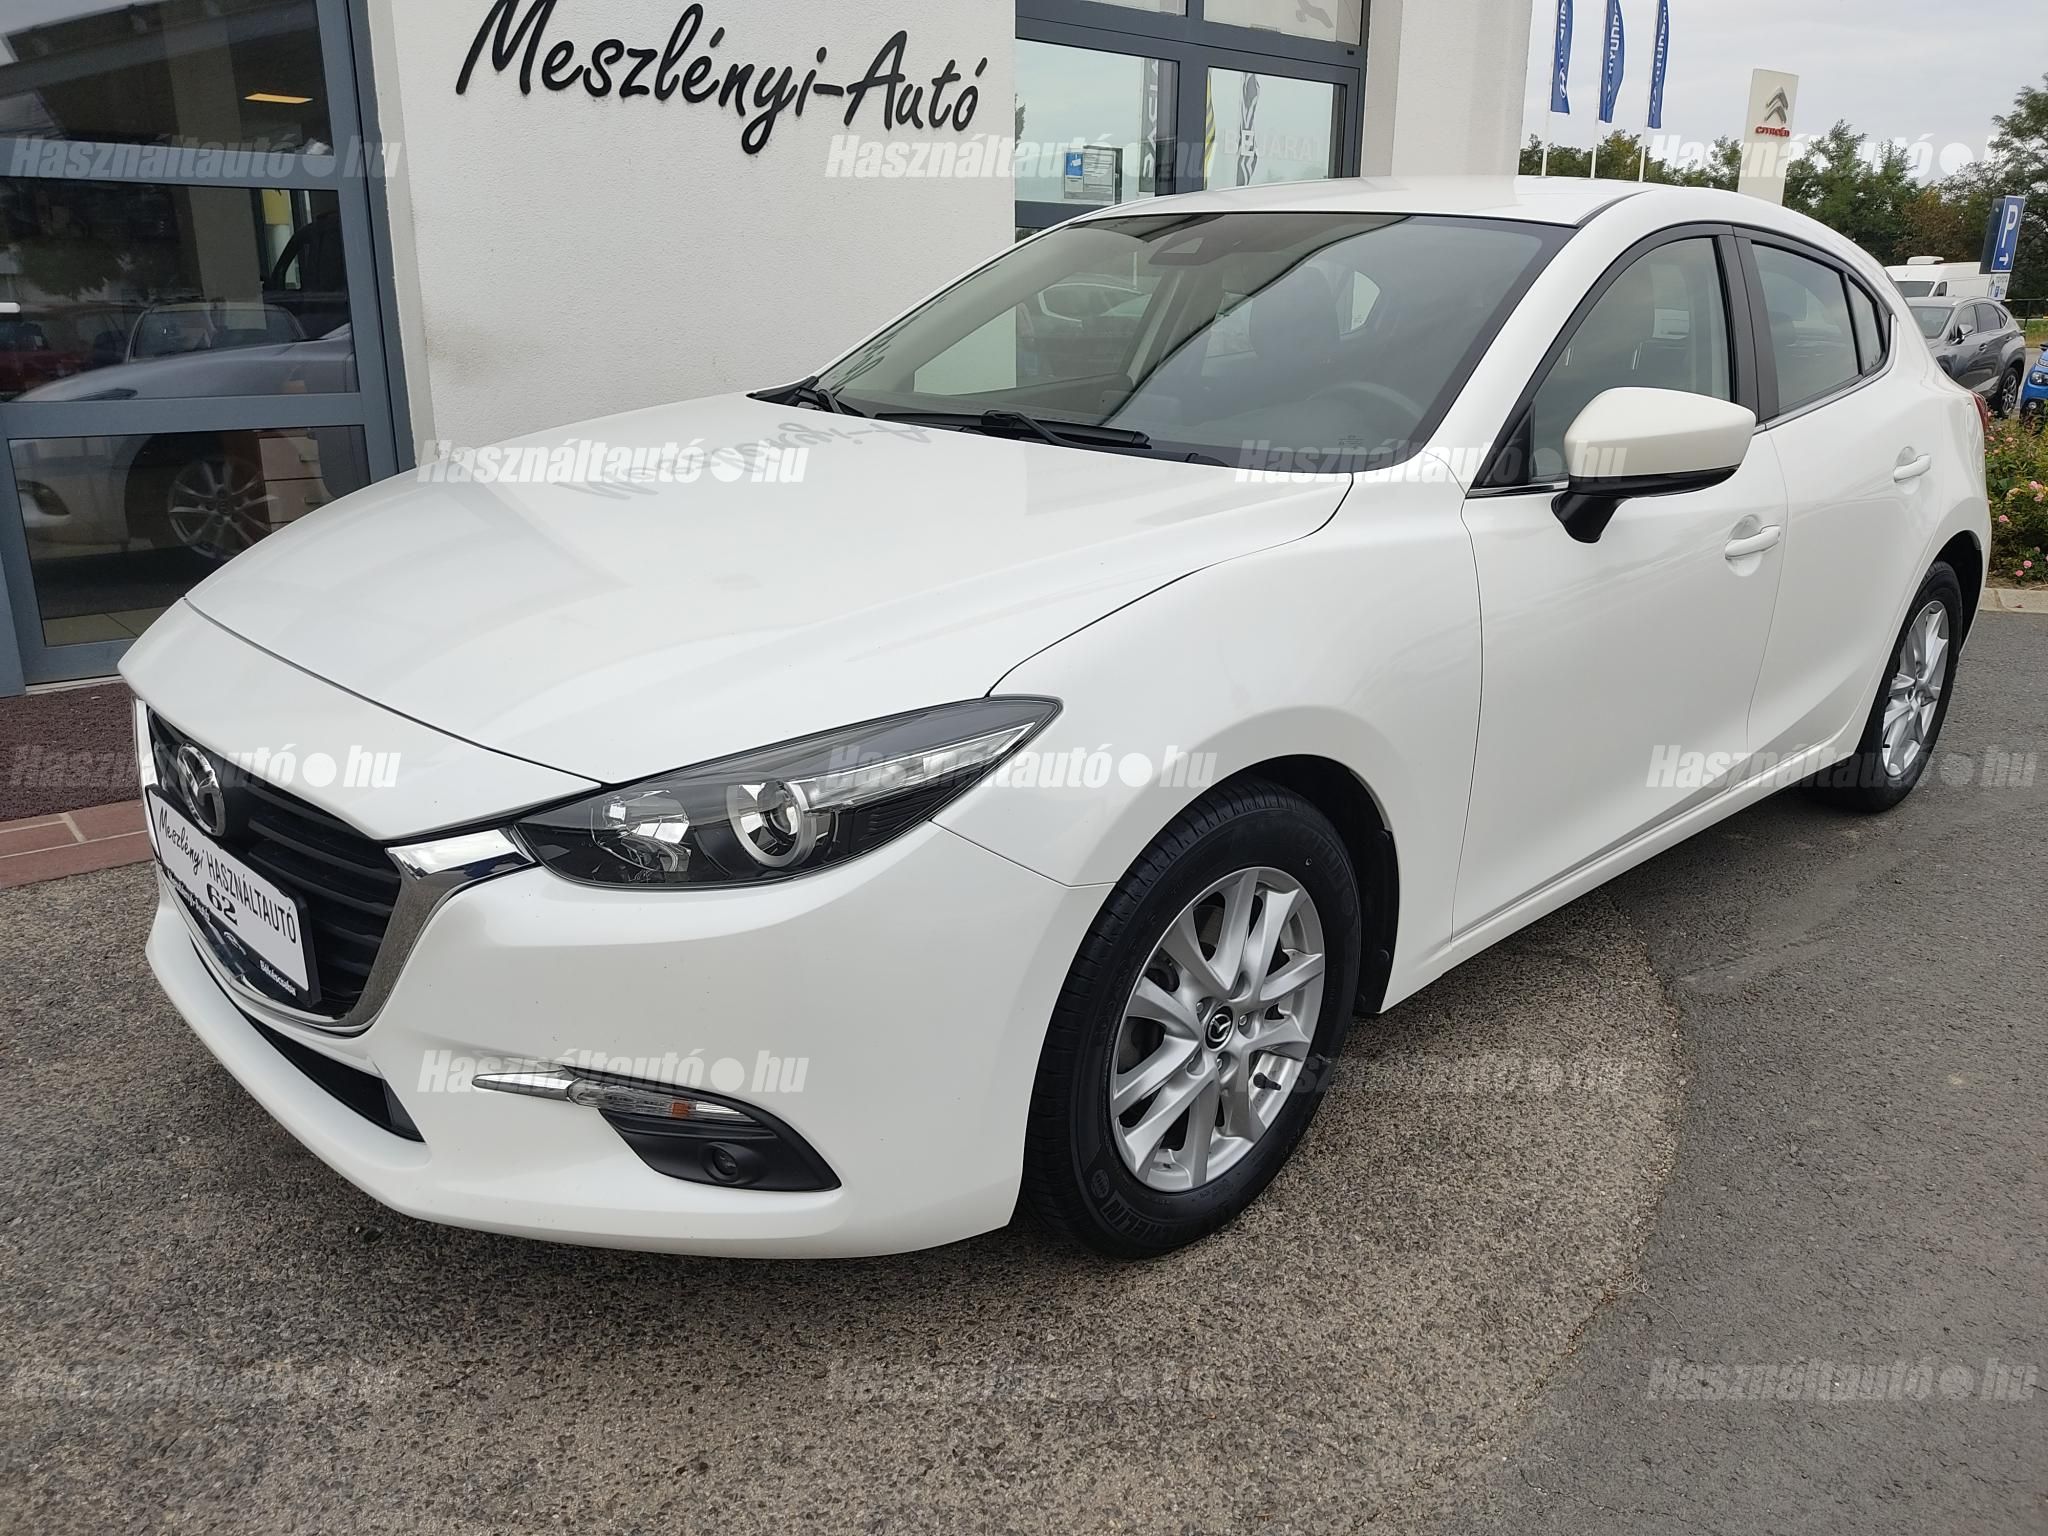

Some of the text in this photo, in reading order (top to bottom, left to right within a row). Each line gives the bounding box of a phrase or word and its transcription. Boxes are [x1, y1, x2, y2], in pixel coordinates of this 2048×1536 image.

[455, 0, 988, 155] Meszlényi-Autó
[160, 806, 205, 876] Meszlényi
[206, 849, 297, 944] HASZNÁLTAUTÓ
[206, 883, 238, 926] 62
